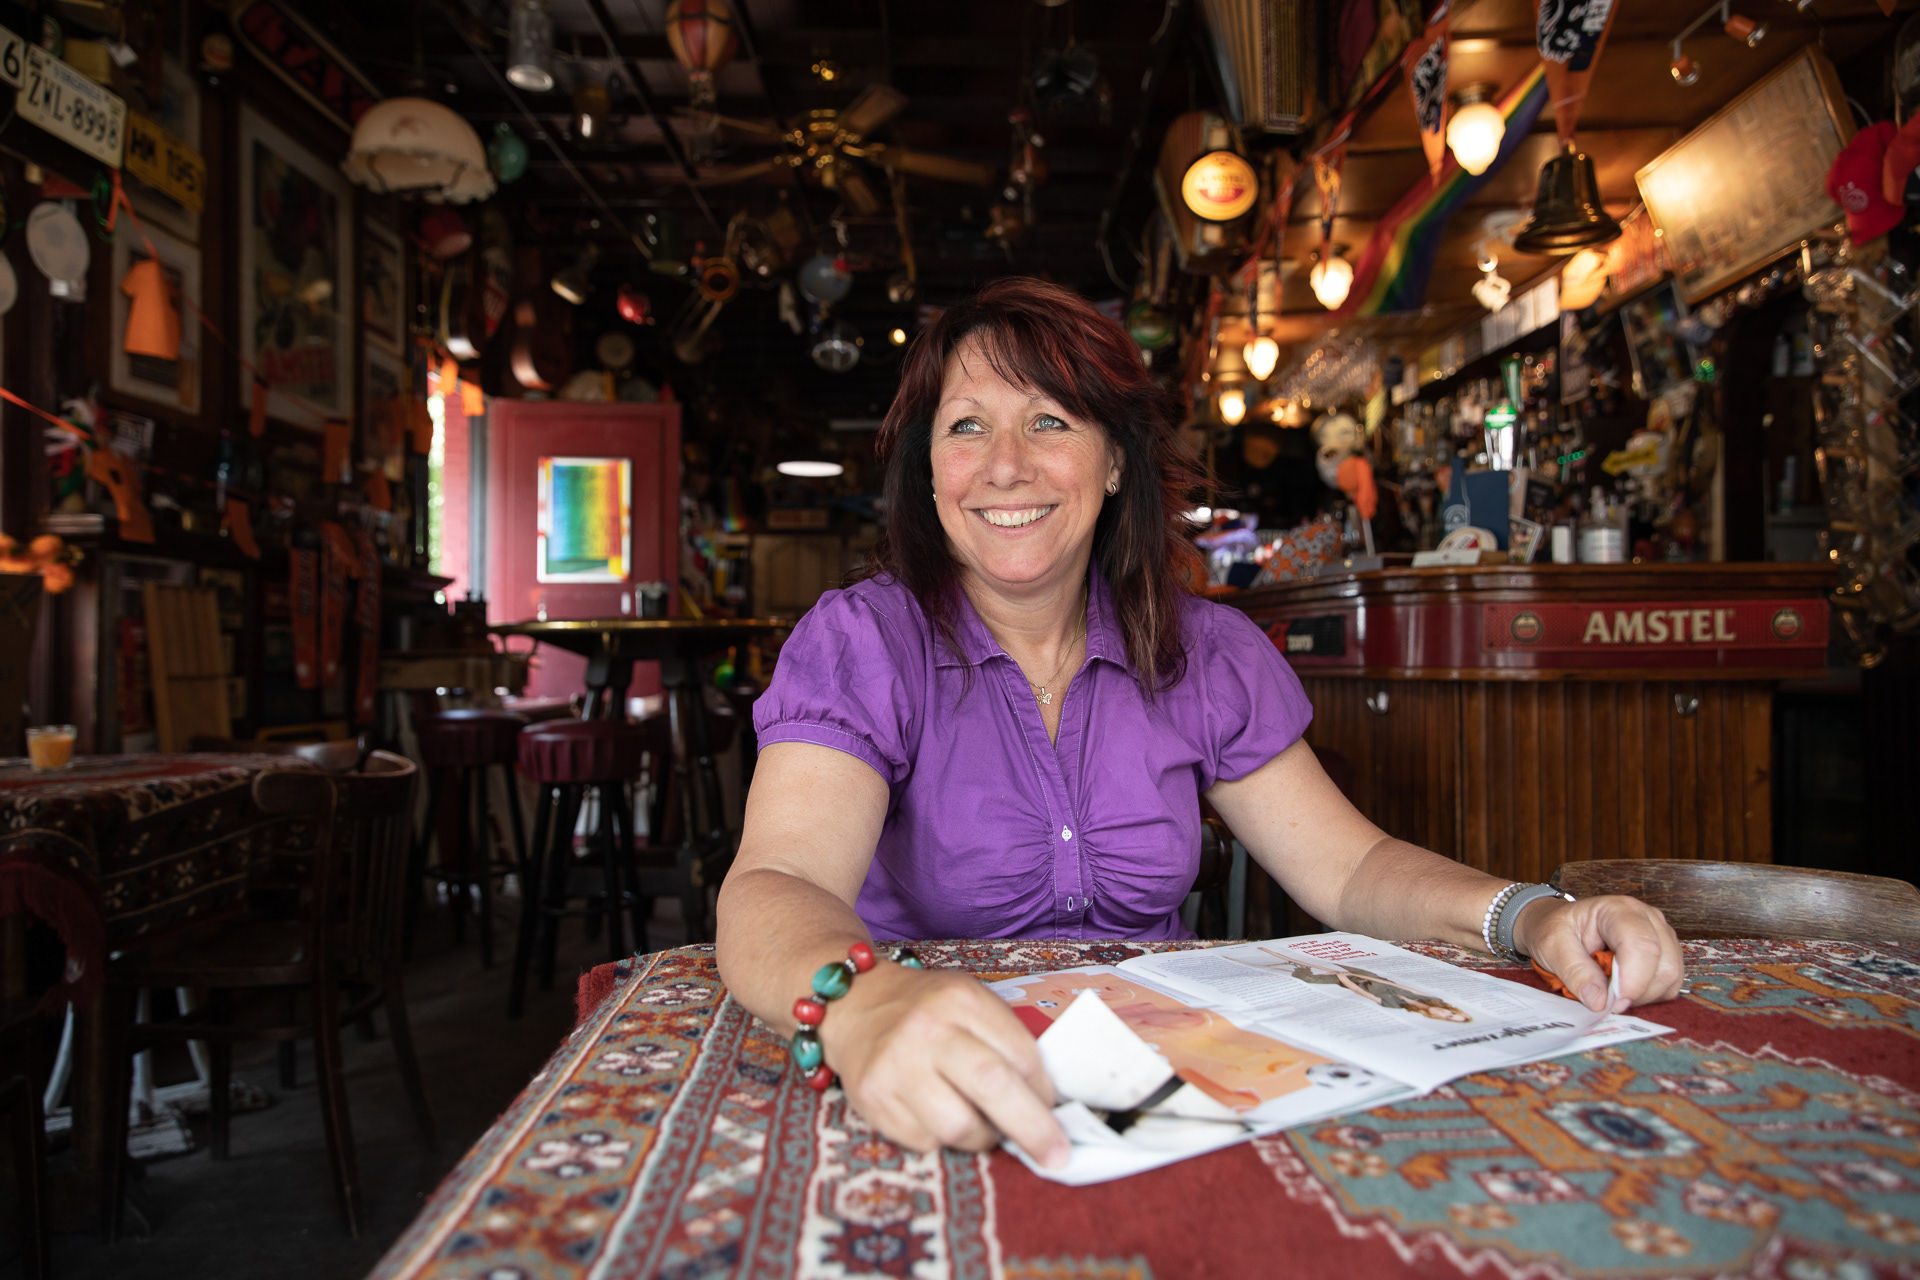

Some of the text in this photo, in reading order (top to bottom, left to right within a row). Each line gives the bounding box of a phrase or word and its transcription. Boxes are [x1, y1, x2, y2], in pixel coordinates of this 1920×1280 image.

[3, 41, 19, 78] 6
[272, 20, 380, 126] TAX
[1582, 609, 1736, 643] AMSTEL
